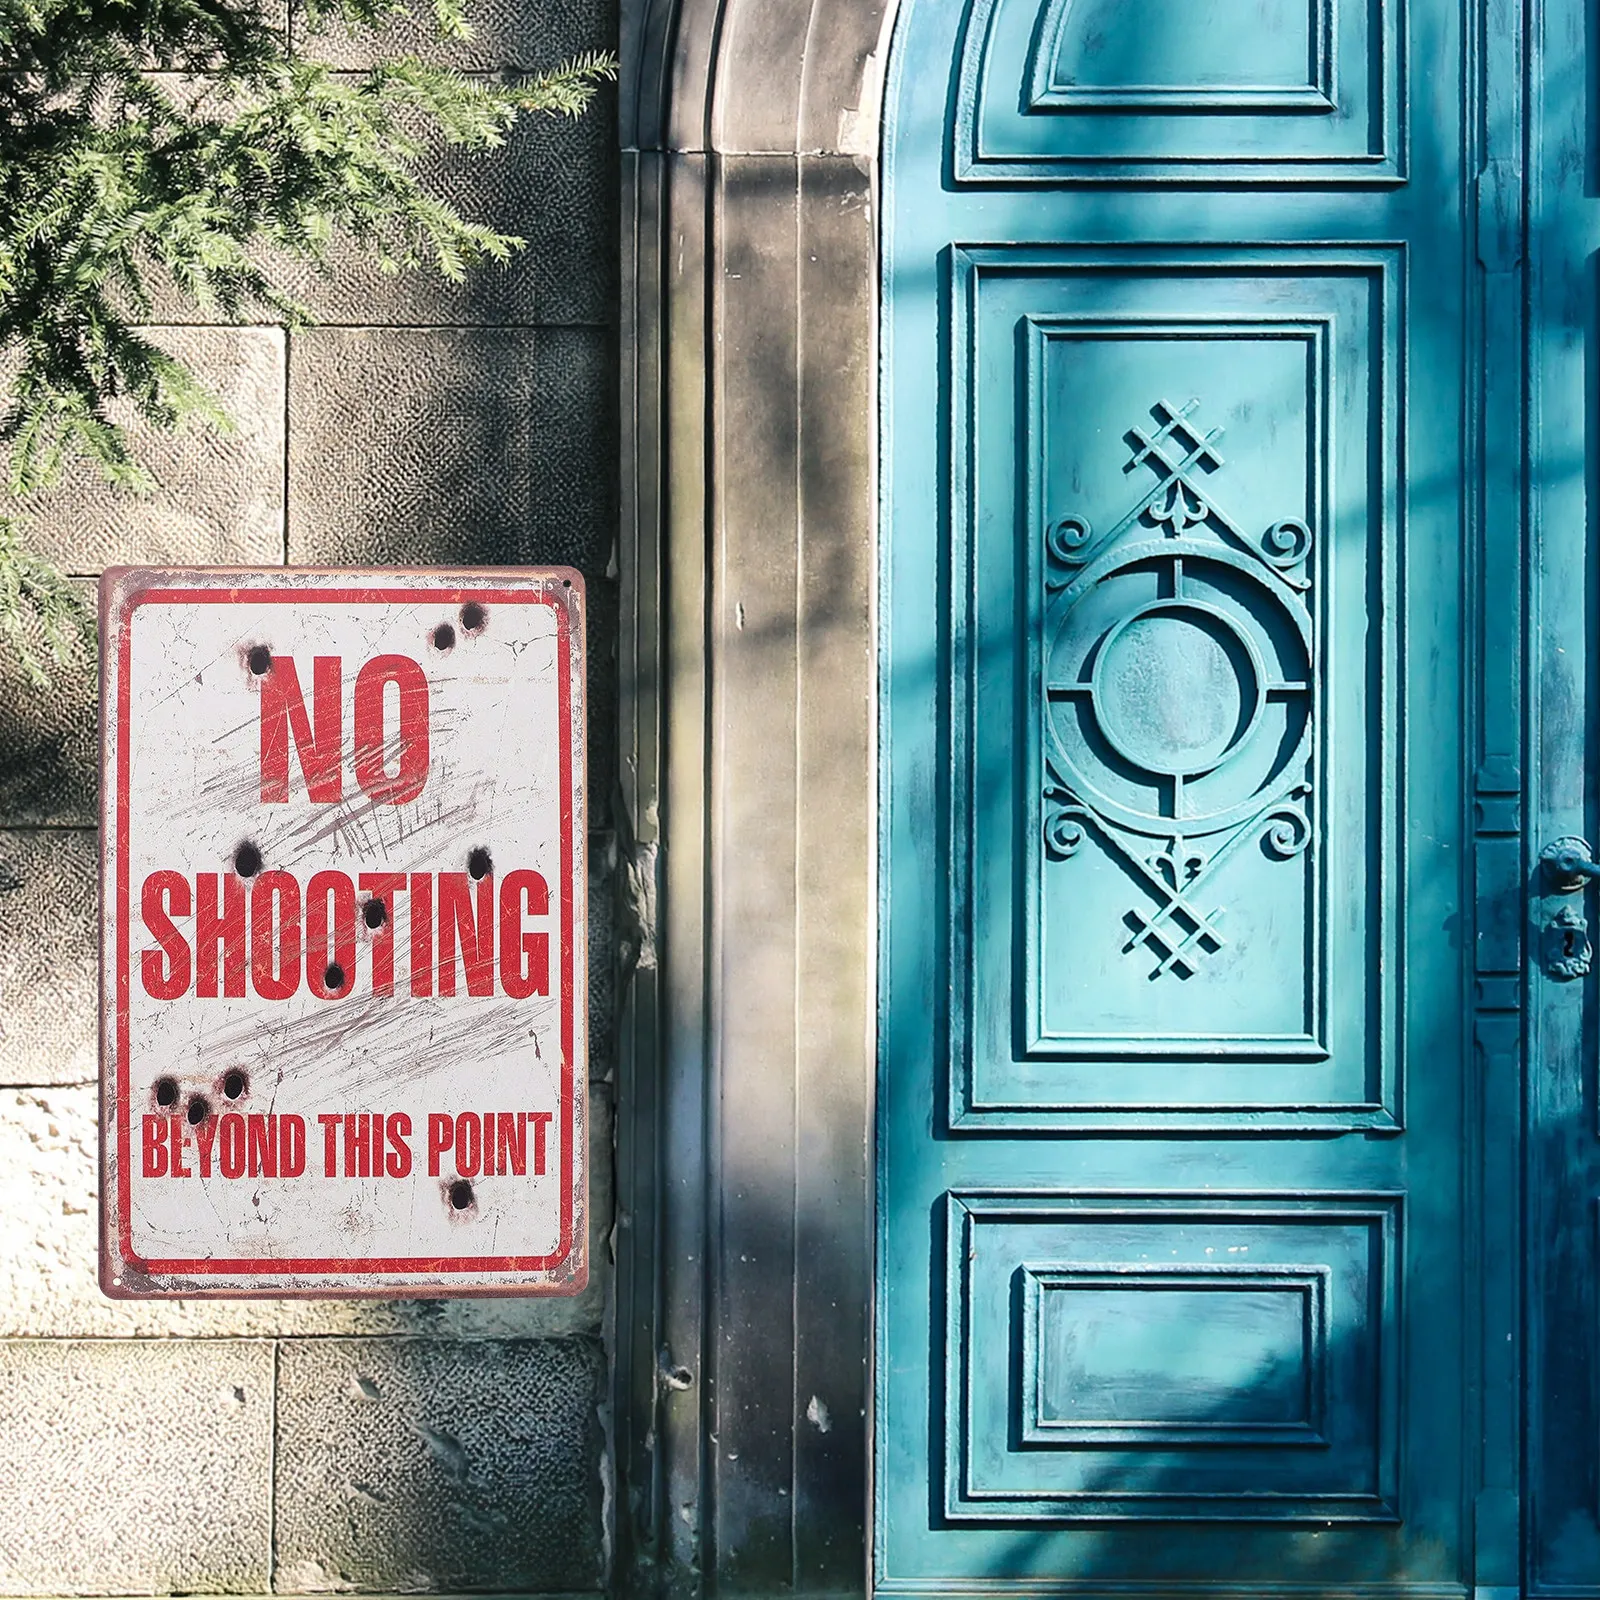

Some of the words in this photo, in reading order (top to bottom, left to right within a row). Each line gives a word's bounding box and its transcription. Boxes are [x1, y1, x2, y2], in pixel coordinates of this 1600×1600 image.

[260, 654, 430, 805] NO
[141, 869, 550, 1001] SHOOTING
[142, 1112, 306, 1179] BEYOND
[317, 1112, 412, 1179] THIS
[427, 1111, 553, 1178] POINT
